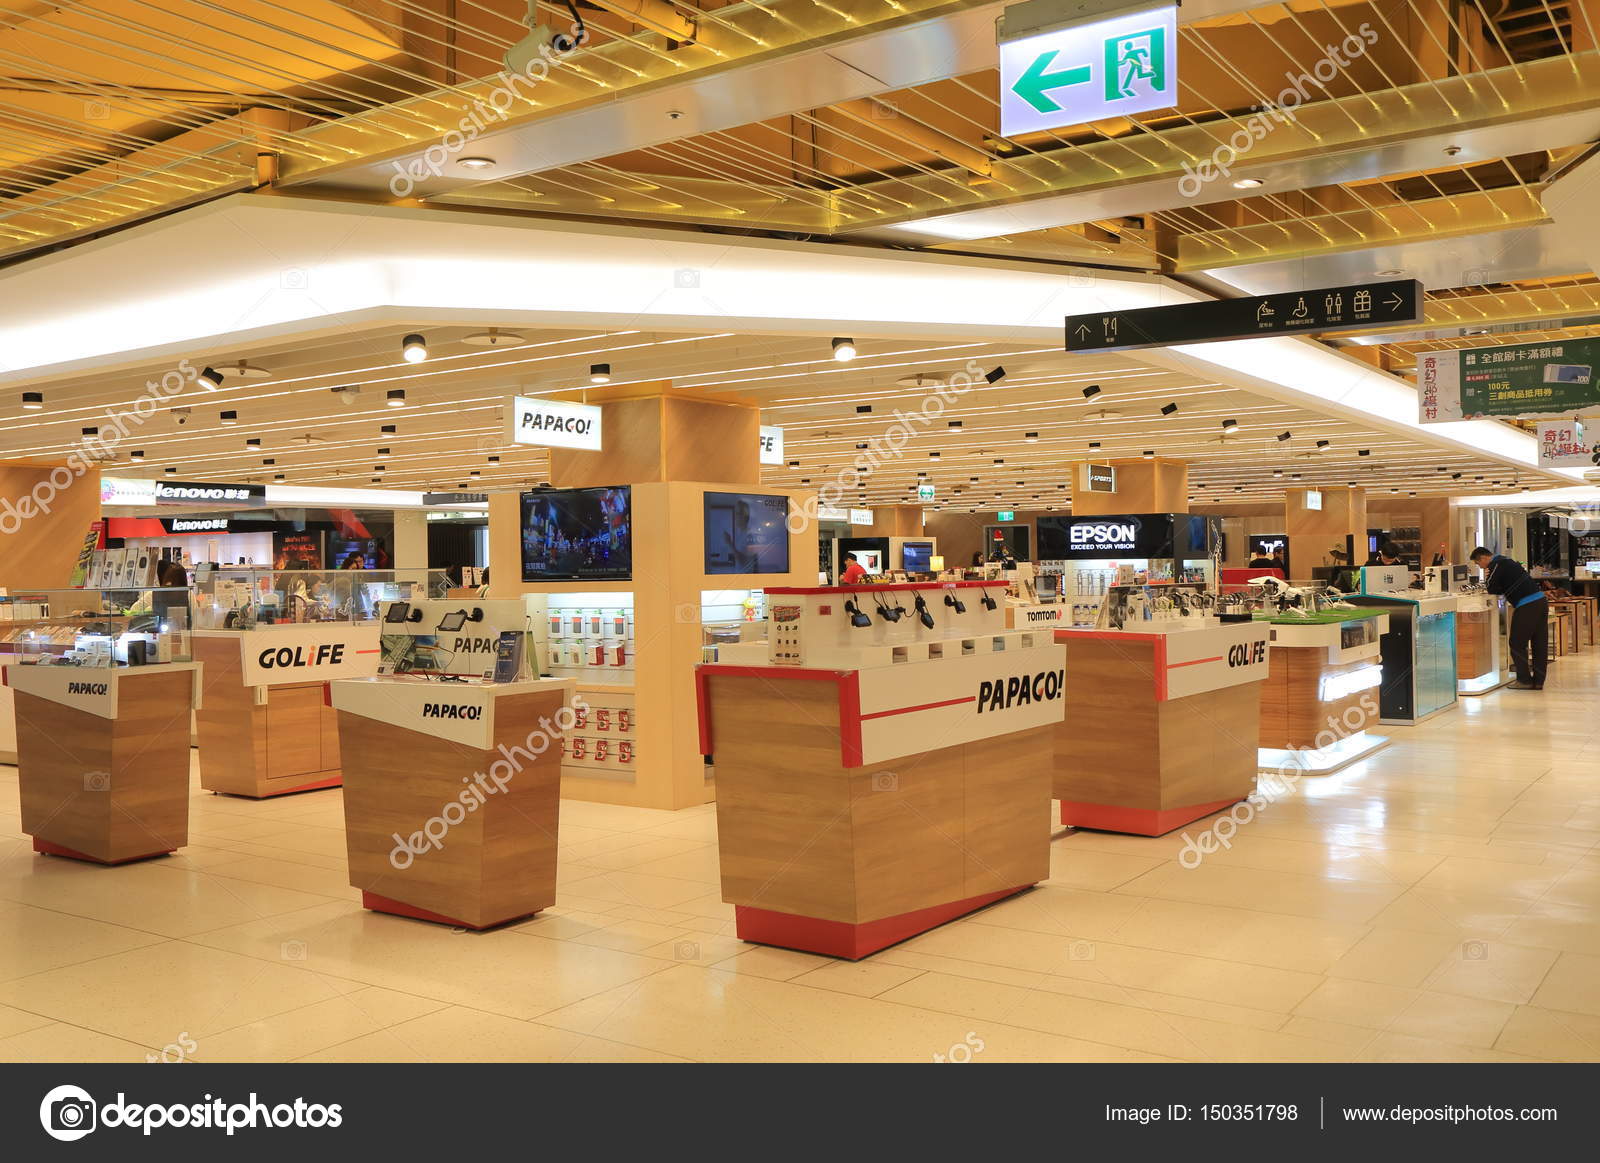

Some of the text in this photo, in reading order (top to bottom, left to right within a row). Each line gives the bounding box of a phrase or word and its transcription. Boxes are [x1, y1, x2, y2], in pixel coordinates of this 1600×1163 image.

[522, 412, 591, 435] PAPAGO!
[1070, 524, 1135, 543] EPSON
[68, 682, 107, 696] PAPAGO!
[977, 669, 1064, 714] PAPAGO!
[423, 703, 482, 720] PAPAGO!
